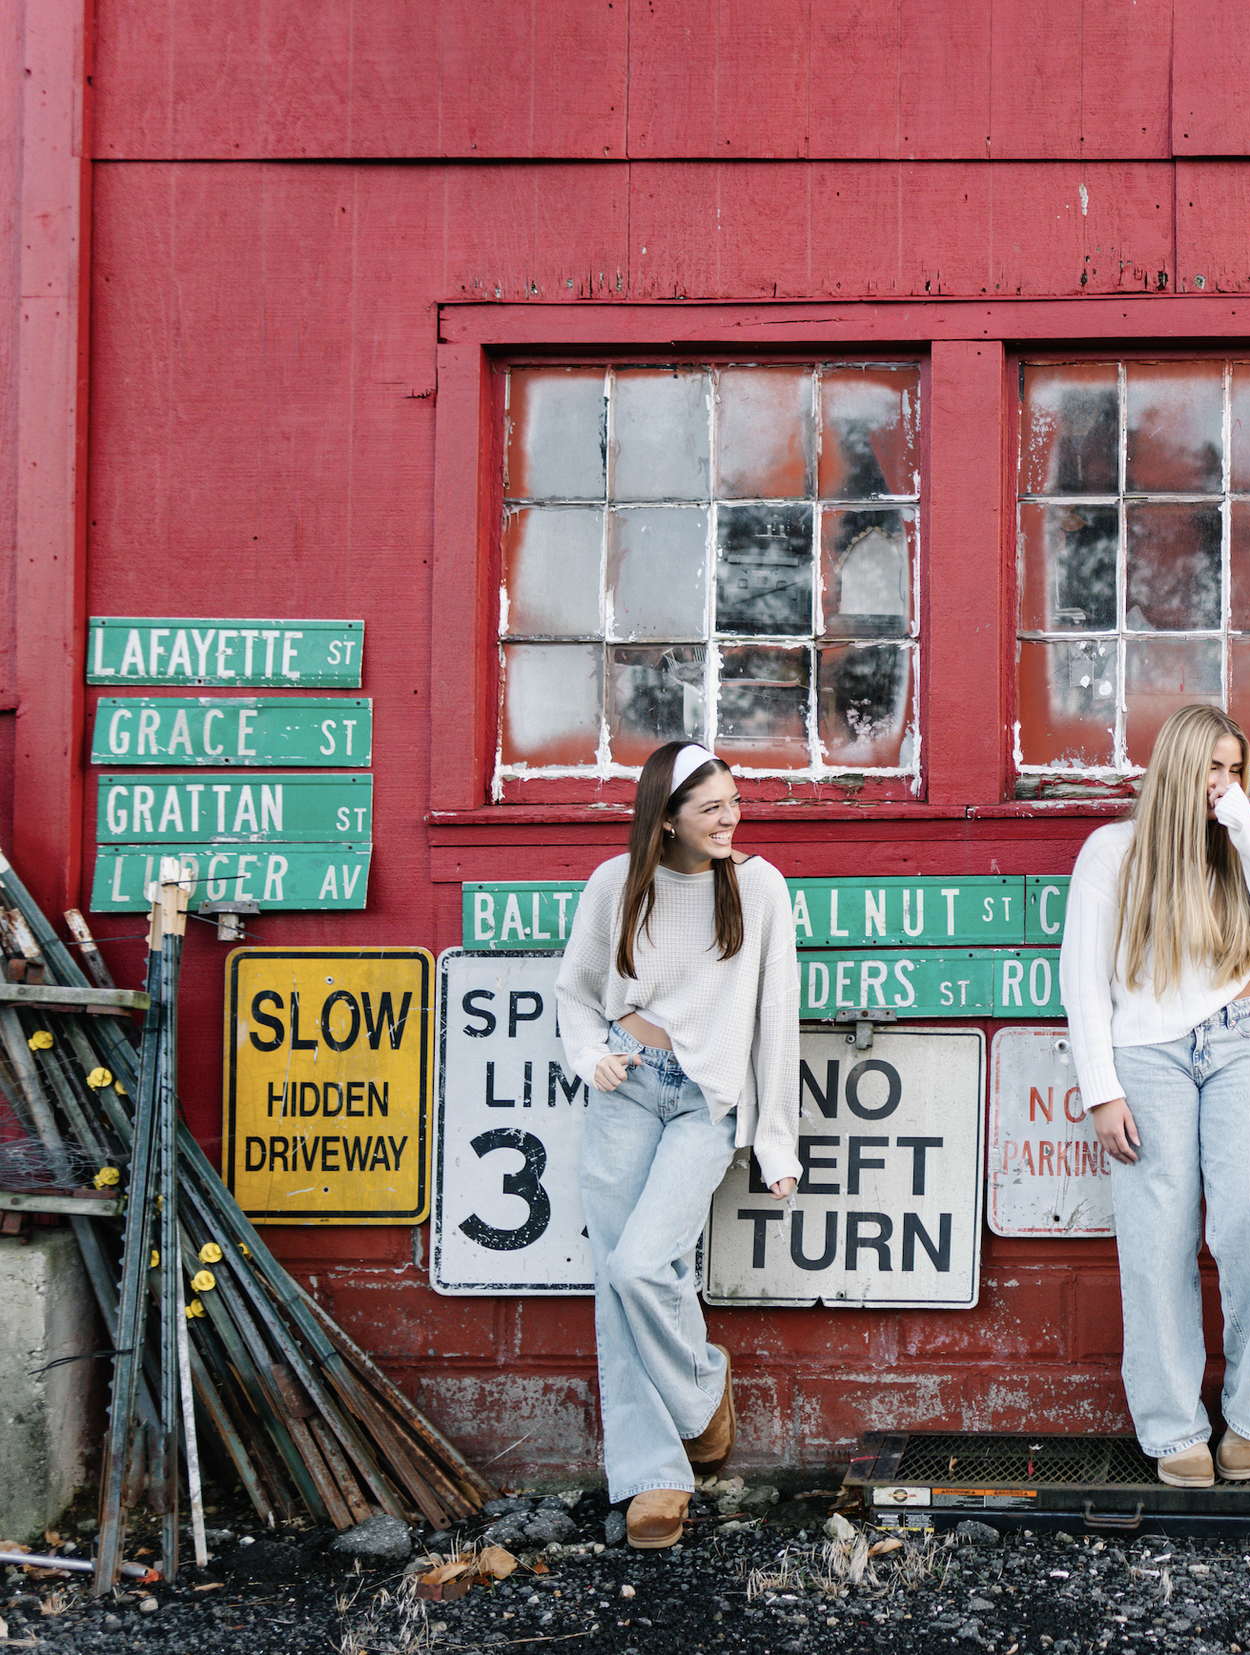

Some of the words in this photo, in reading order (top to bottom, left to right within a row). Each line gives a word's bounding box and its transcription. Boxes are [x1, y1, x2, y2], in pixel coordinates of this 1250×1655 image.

[94, 628, 303, 678] LAFAYETTE
[327, 639, 355, 665] ST
[108, 709, 258, 756] GRACE
[319, 719, 357, 756] ST
[106, 784, 283, 834] GRATTAN
[336, 806, 366, 832] ST
[318, 864, 361, 900] AV
[474, 891, 582, 941] BALT
[791, 888, 960, 938] ALNUT
[983, 896, 1012, 923] ST
[1039, 885, 1061, 936] C
[797, 958, 916, 1009] DERS
[940, 979, 970, 1007] ST
[1002, 957, 1063, 1008] RO
[249, 989, 413, 1052] SLOW
[462, 989, 561, 1039] SP
[267, 1081, 389, 1118] HIDDEN
[485, 1061, 590, 1109] LIM
[799, 1058, 902, 1121] NO
[1029, 1086, 1087, 1124] NO
[245, 1135, 408, 1172] DRIVEWAY
[458, 1127, 590, 1252] 3
[738, 1208, 953, 1273] TURN
